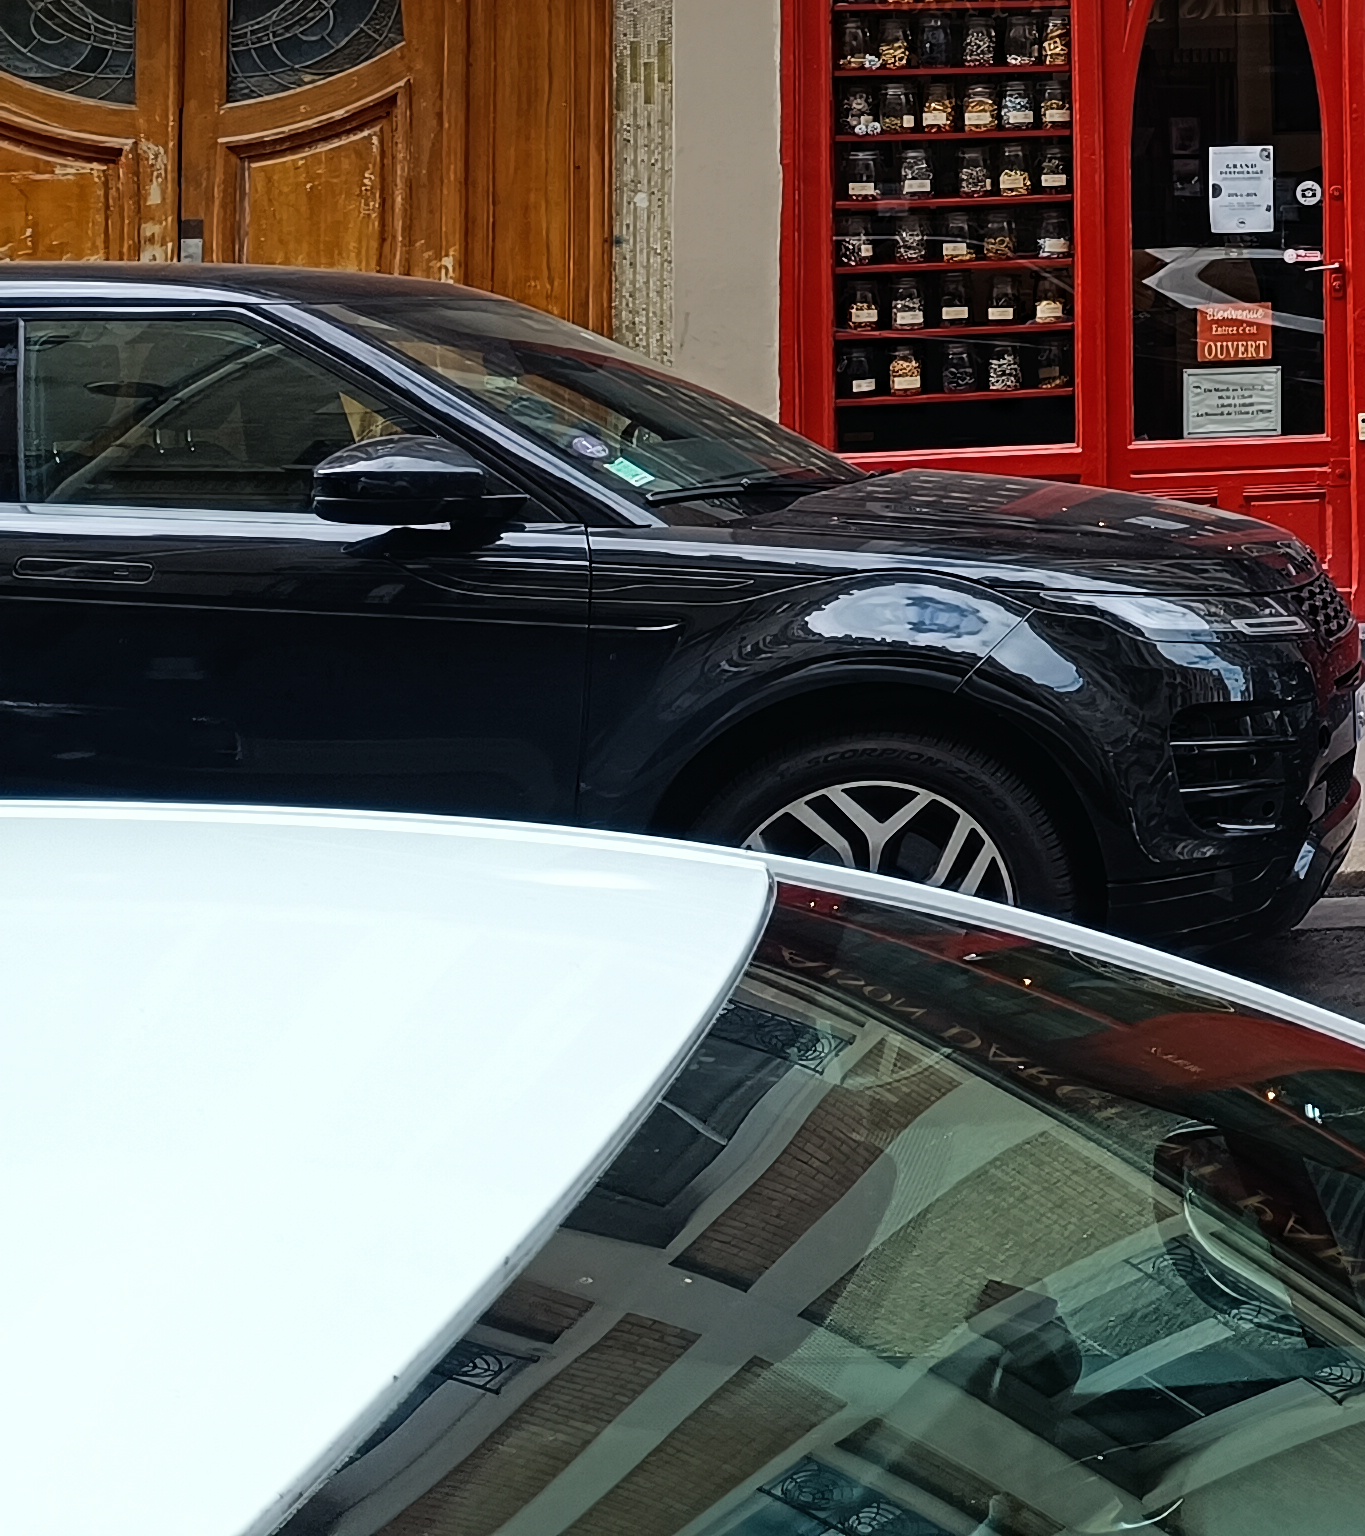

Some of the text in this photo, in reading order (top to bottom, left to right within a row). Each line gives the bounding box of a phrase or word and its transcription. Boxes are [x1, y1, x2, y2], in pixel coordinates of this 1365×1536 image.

[1206, 308, 1265, 321] Bienvenue
[1211, 324, 1237, 335] Entrez
[1204, 340, 1268, 359] OUVERT
[807, 747, 1007, 811] SCORPION ZERO
